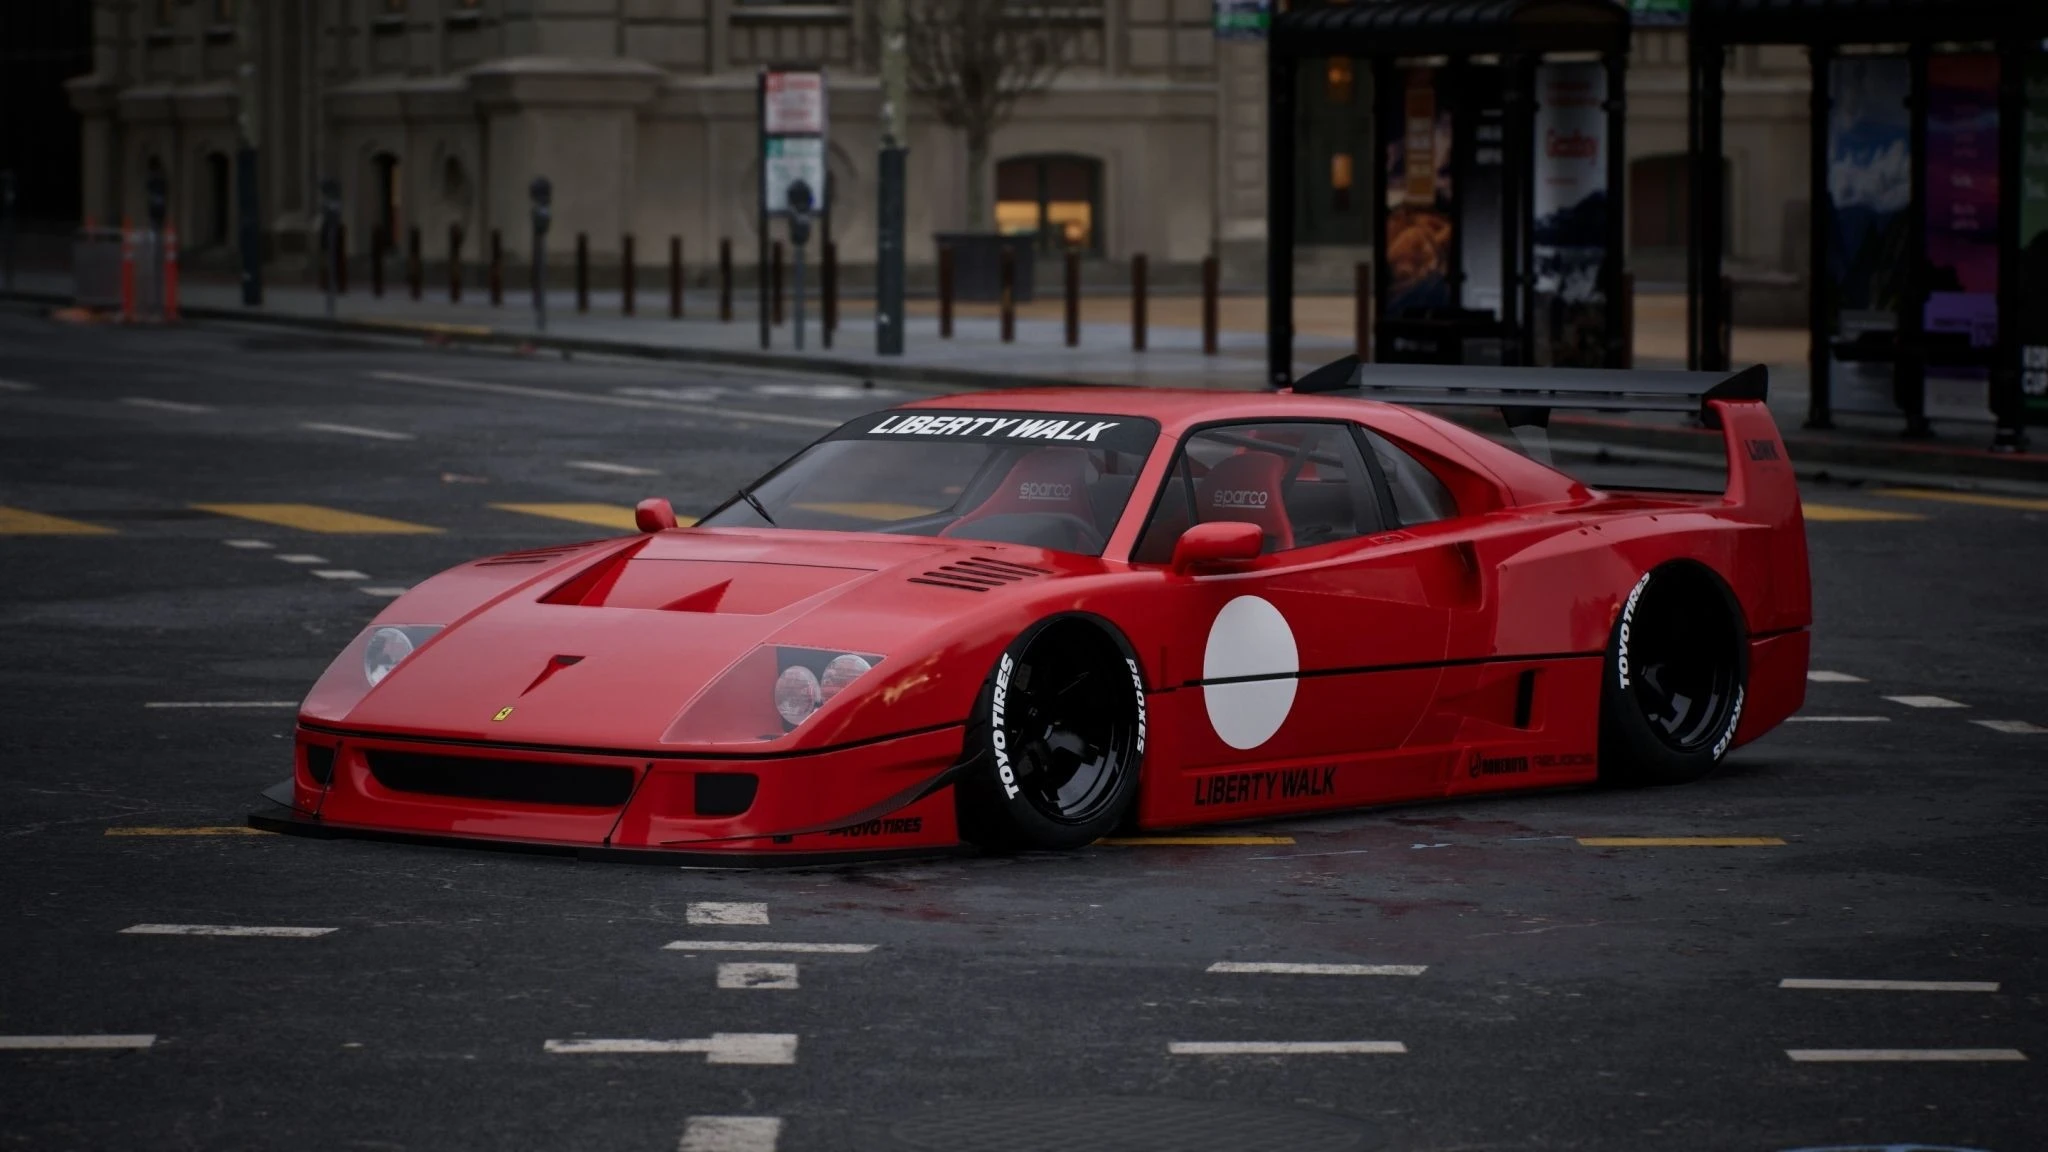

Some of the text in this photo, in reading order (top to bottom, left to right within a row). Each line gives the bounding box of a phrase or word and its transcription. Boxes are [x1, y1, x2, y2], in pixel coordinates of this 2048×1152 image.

[867, 415, 1120, 442] LIBERTY WALK
[1019, 482, 1072, 501] sparco
[1213, 490, 1268, 508] sparco
[1618, 622, 1631, 690] TOYO
[1125, 657, 1146, 755] PROXES
[992, 652, 1020, 801] TOYO TIRES
[1195, 766, 1338, 806] LIBERTY WALK
[883, 817, 922, 834] TIRES
